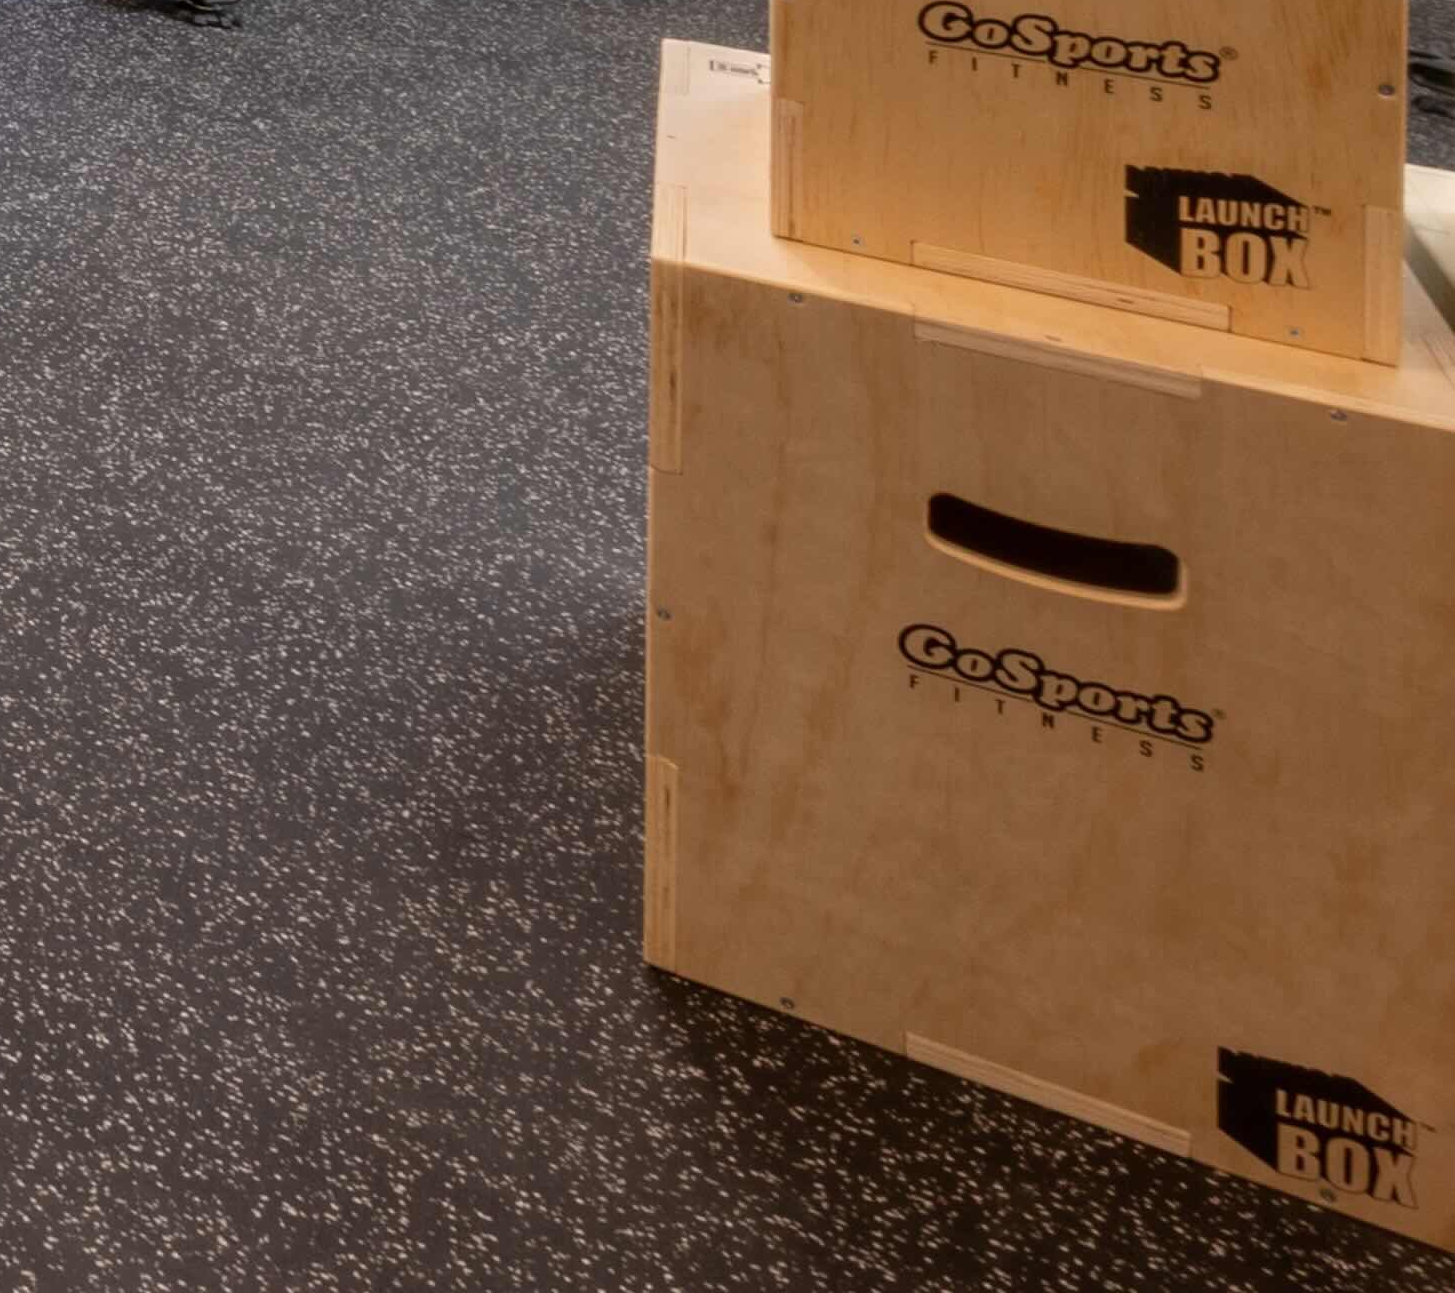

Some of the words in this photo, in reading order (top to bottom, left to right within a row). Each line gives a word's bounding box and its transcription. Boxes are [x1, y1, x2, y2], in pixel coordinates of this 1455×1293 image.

[917, 0, 1222, 84] GoSports
[927, 50, 1213, 111] FITNESS
[1178, 195, 1310, 235] LAUNCH
[1180, 228, 1312, 290] BOX
[897, 623, 1216, 744] GoSports
[908, 674, 1205, 773] FITNESS
[1275, 1088, 1418, 1151] LAUNCH
[1276, 1122, 1420, 1210] BOX
